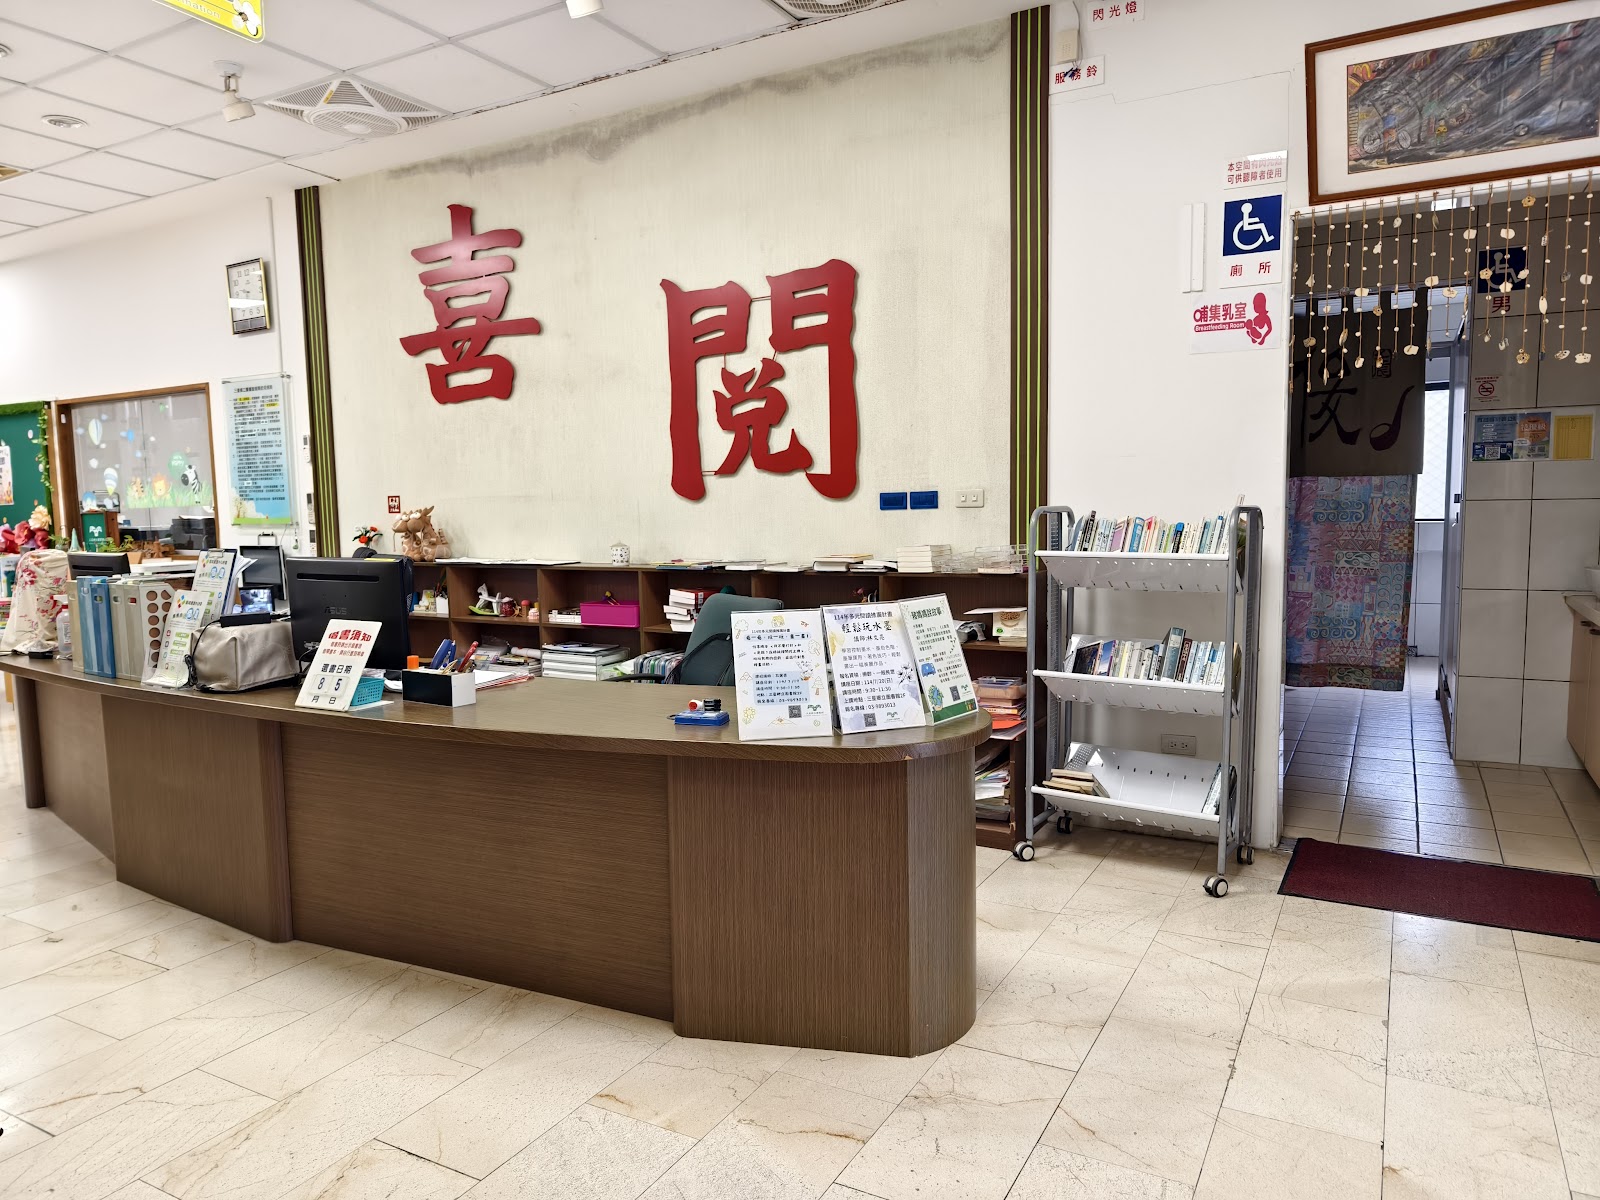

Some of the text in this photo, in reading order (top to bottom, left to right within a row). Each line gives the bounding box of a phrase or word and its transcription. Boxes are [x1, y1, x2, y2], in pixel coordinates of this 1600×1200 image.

[1092, 0, 1137, 22] 閃光燈
[1228, 168, 1282, 185] 可供聽障者使用
[1230, 261, 1271, 277] 廁所
[1193, 302, 1247, 323] 哺集乳室
[1195, 322, 1245, 332] Breastfeeding Room
[841, 620, 892, 634] 輕鬆玩水墨
[321, 663, 352, 674] 還書日期
[317, 677, 343, 691] 8 5
[311, 695, 337, 704] 月 日
